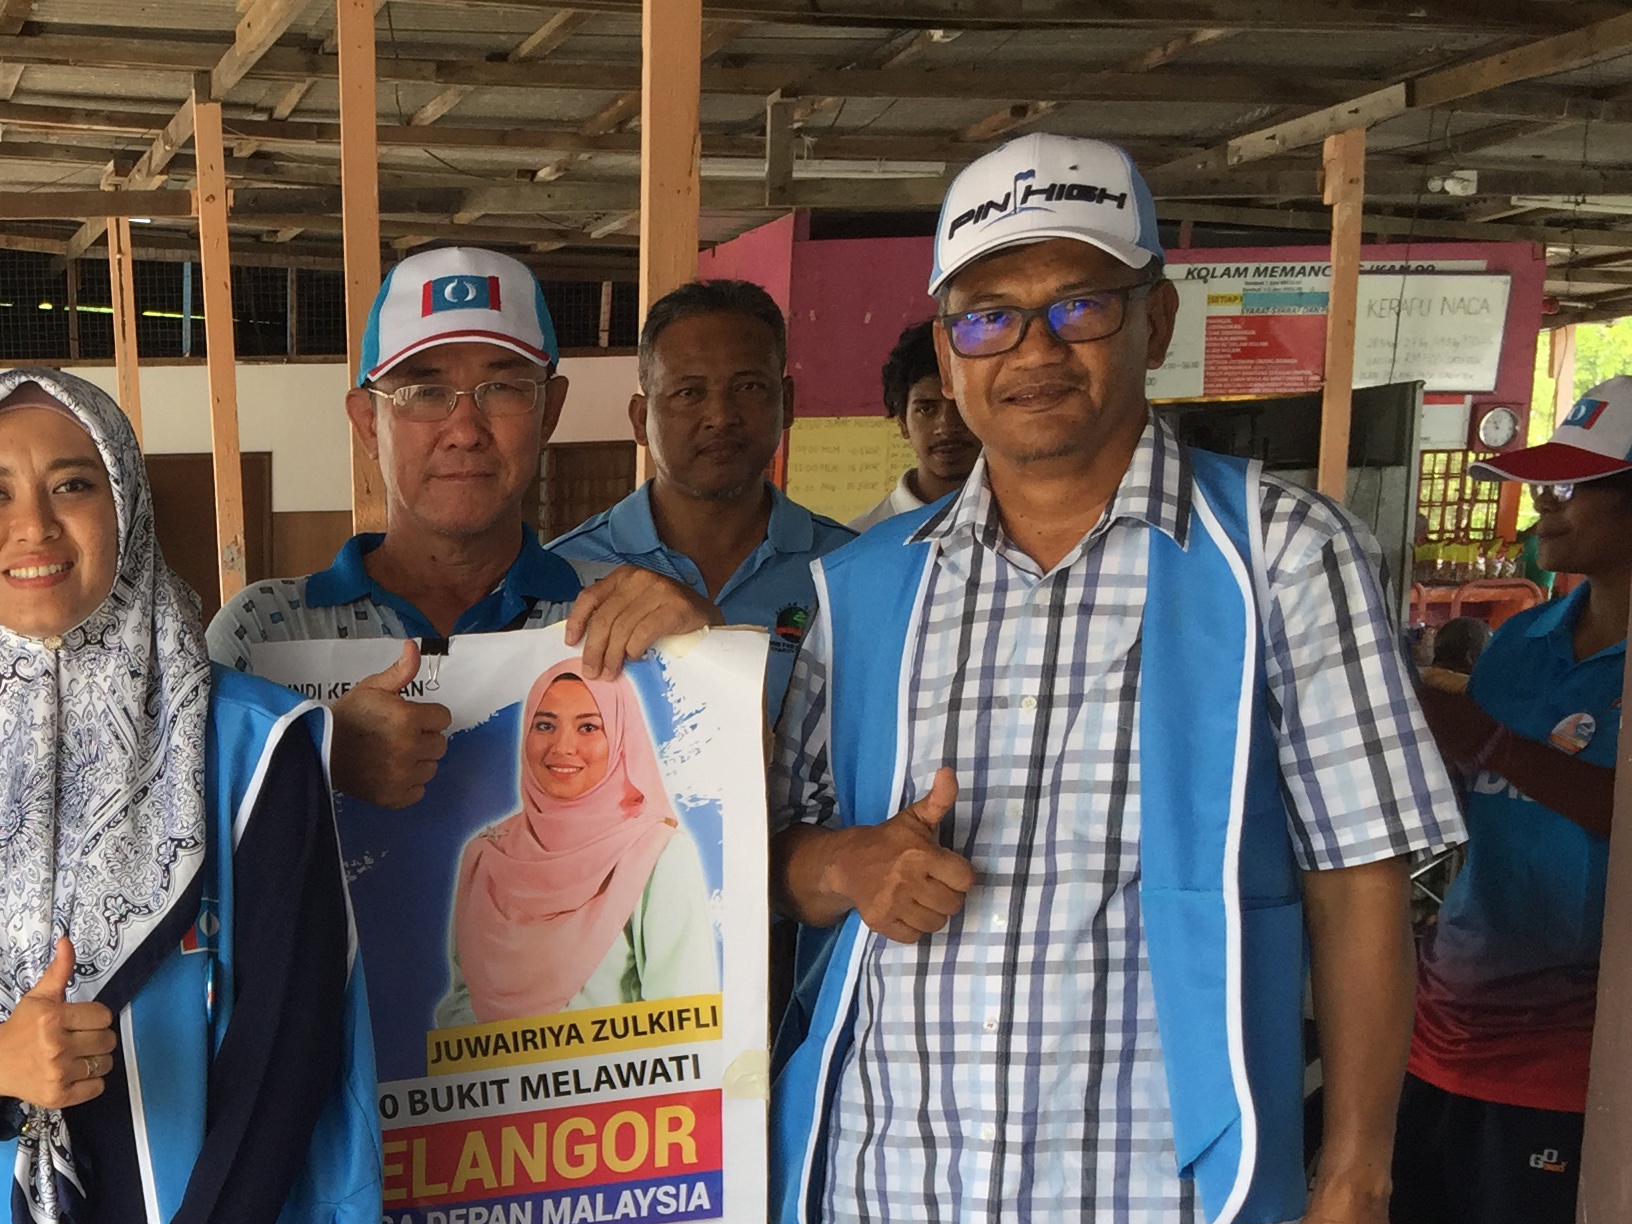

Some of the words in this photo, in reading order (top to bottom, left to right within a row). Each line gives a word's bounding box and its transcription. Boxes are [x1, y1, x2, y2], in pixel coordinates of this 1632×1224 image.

[948, 192, 1011, 240] PIN
[1020, 183, 1127, 210] HIGH
[1185, 266, 1249, 280] KOLAM
[430, 1023, 584, 1064] JUWAIRIYA
[591, 1005, 719, 1042] ZULKIFLI
[409, 1078, 510, 1117] BUKIT
[520, 1053, 701, 1102] MELAWATI
[382, 1105, 698, 1200] ELANGOR
